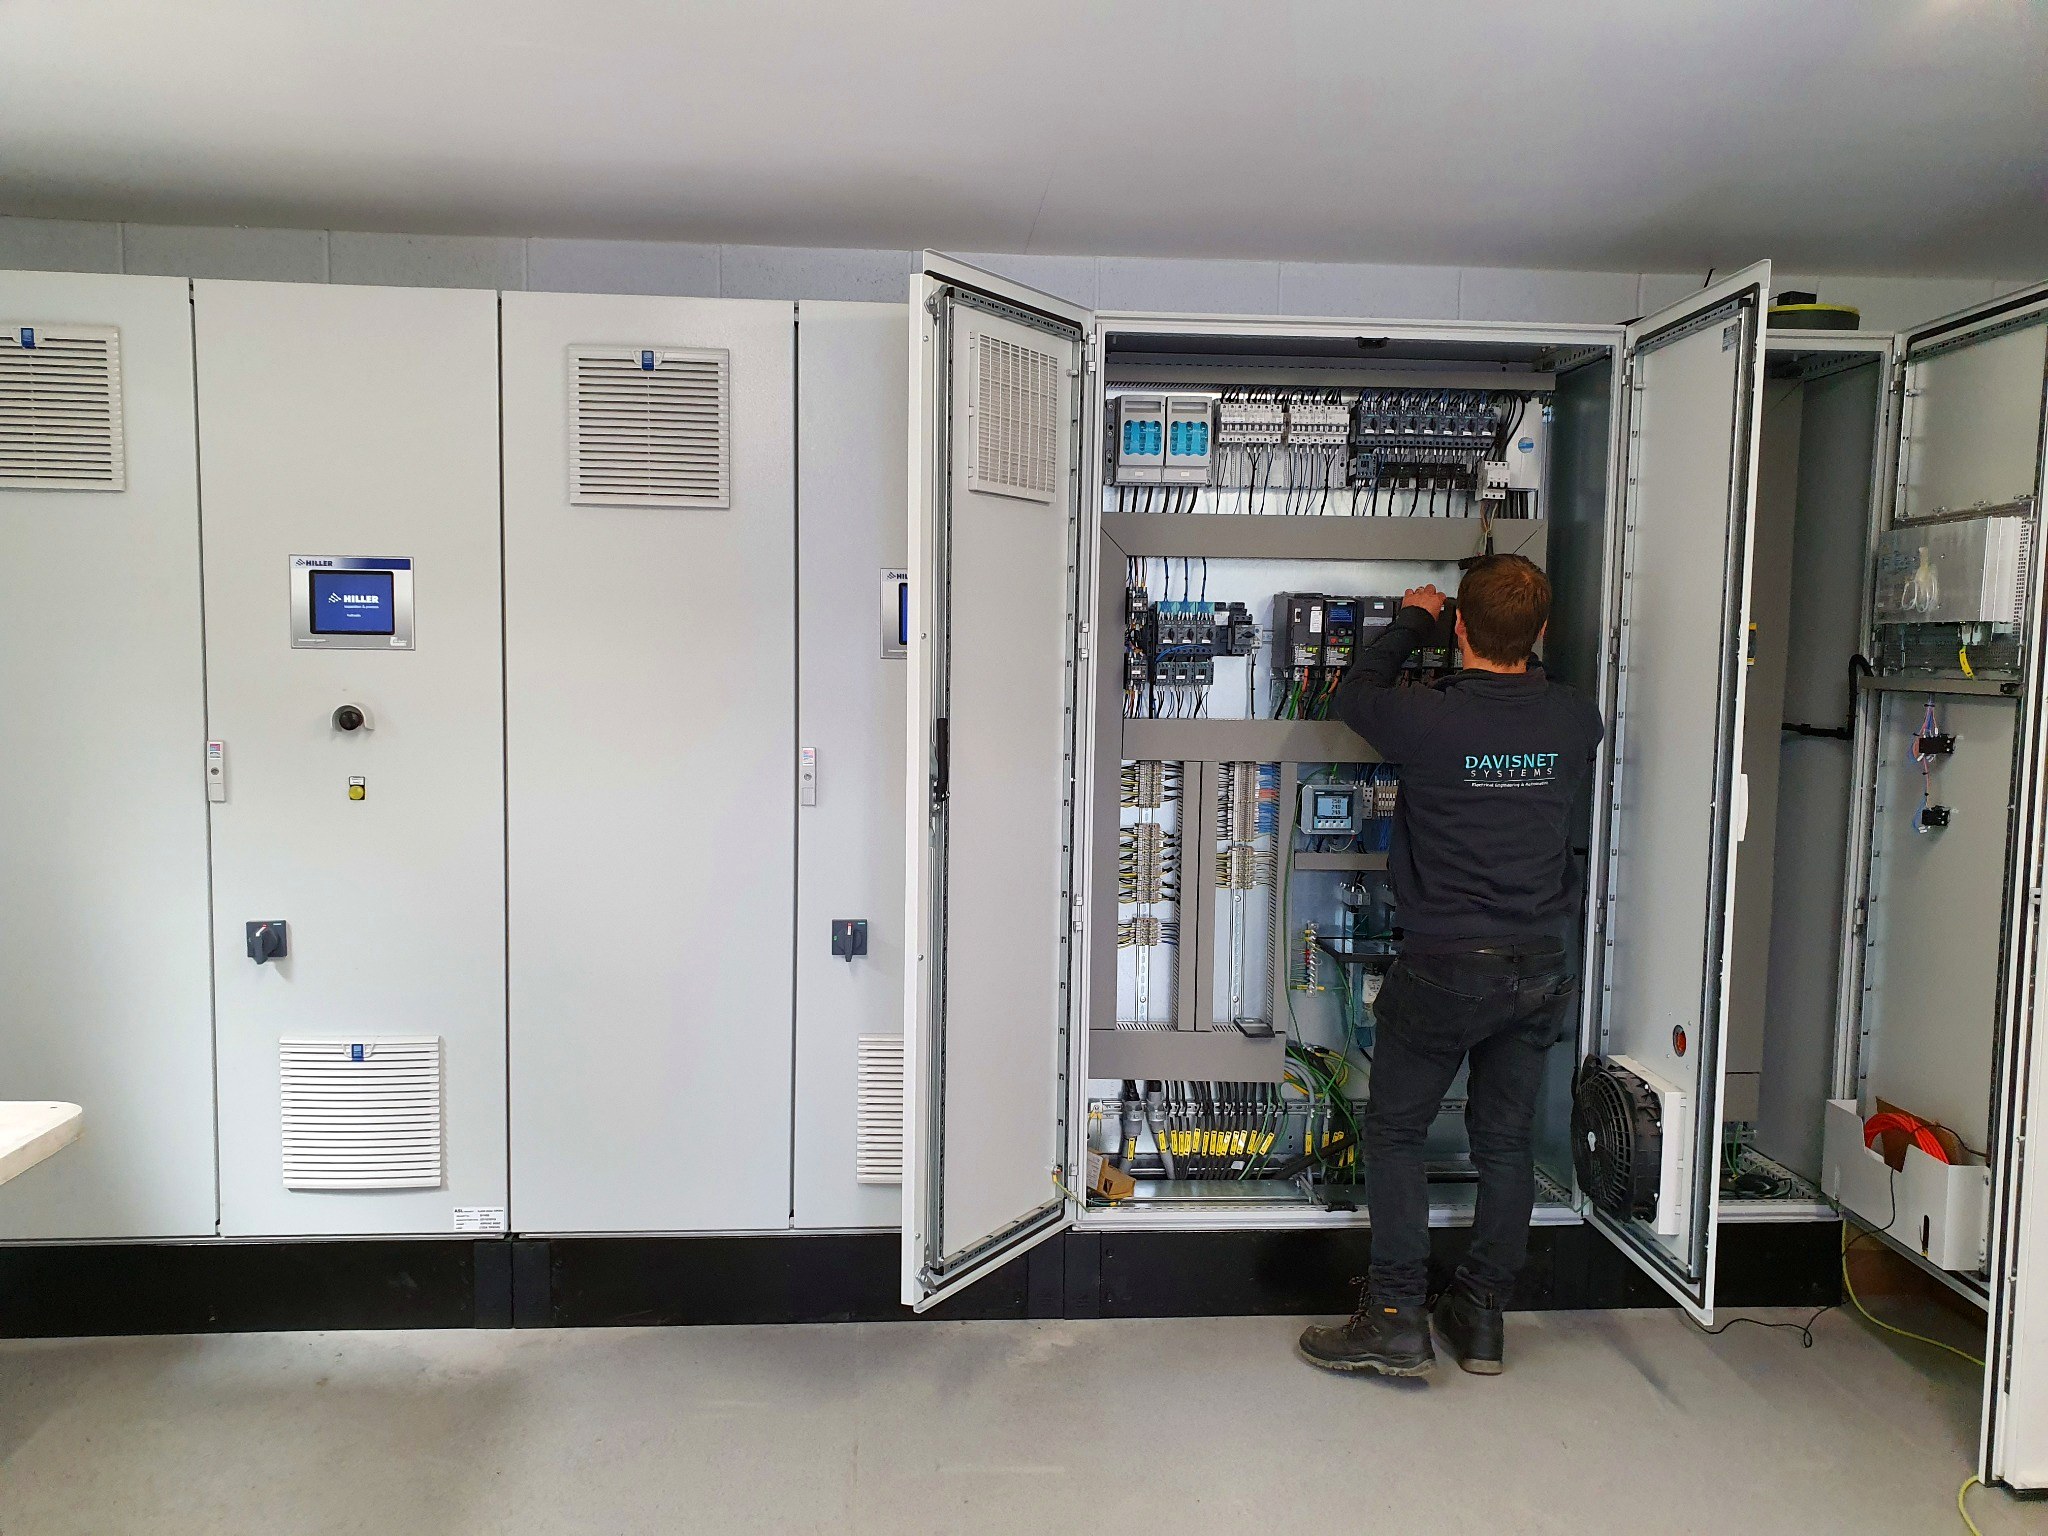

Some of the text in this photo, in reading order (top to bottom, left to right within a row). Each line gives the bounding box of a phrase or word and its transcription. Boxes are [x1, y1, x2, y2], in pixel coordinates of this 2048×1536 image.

[343, 594, 379, 604] HILLER
[1465, 753, 1559, 769] DAVISNET
[1470, 767, 1553, 778] SYSTEMS
